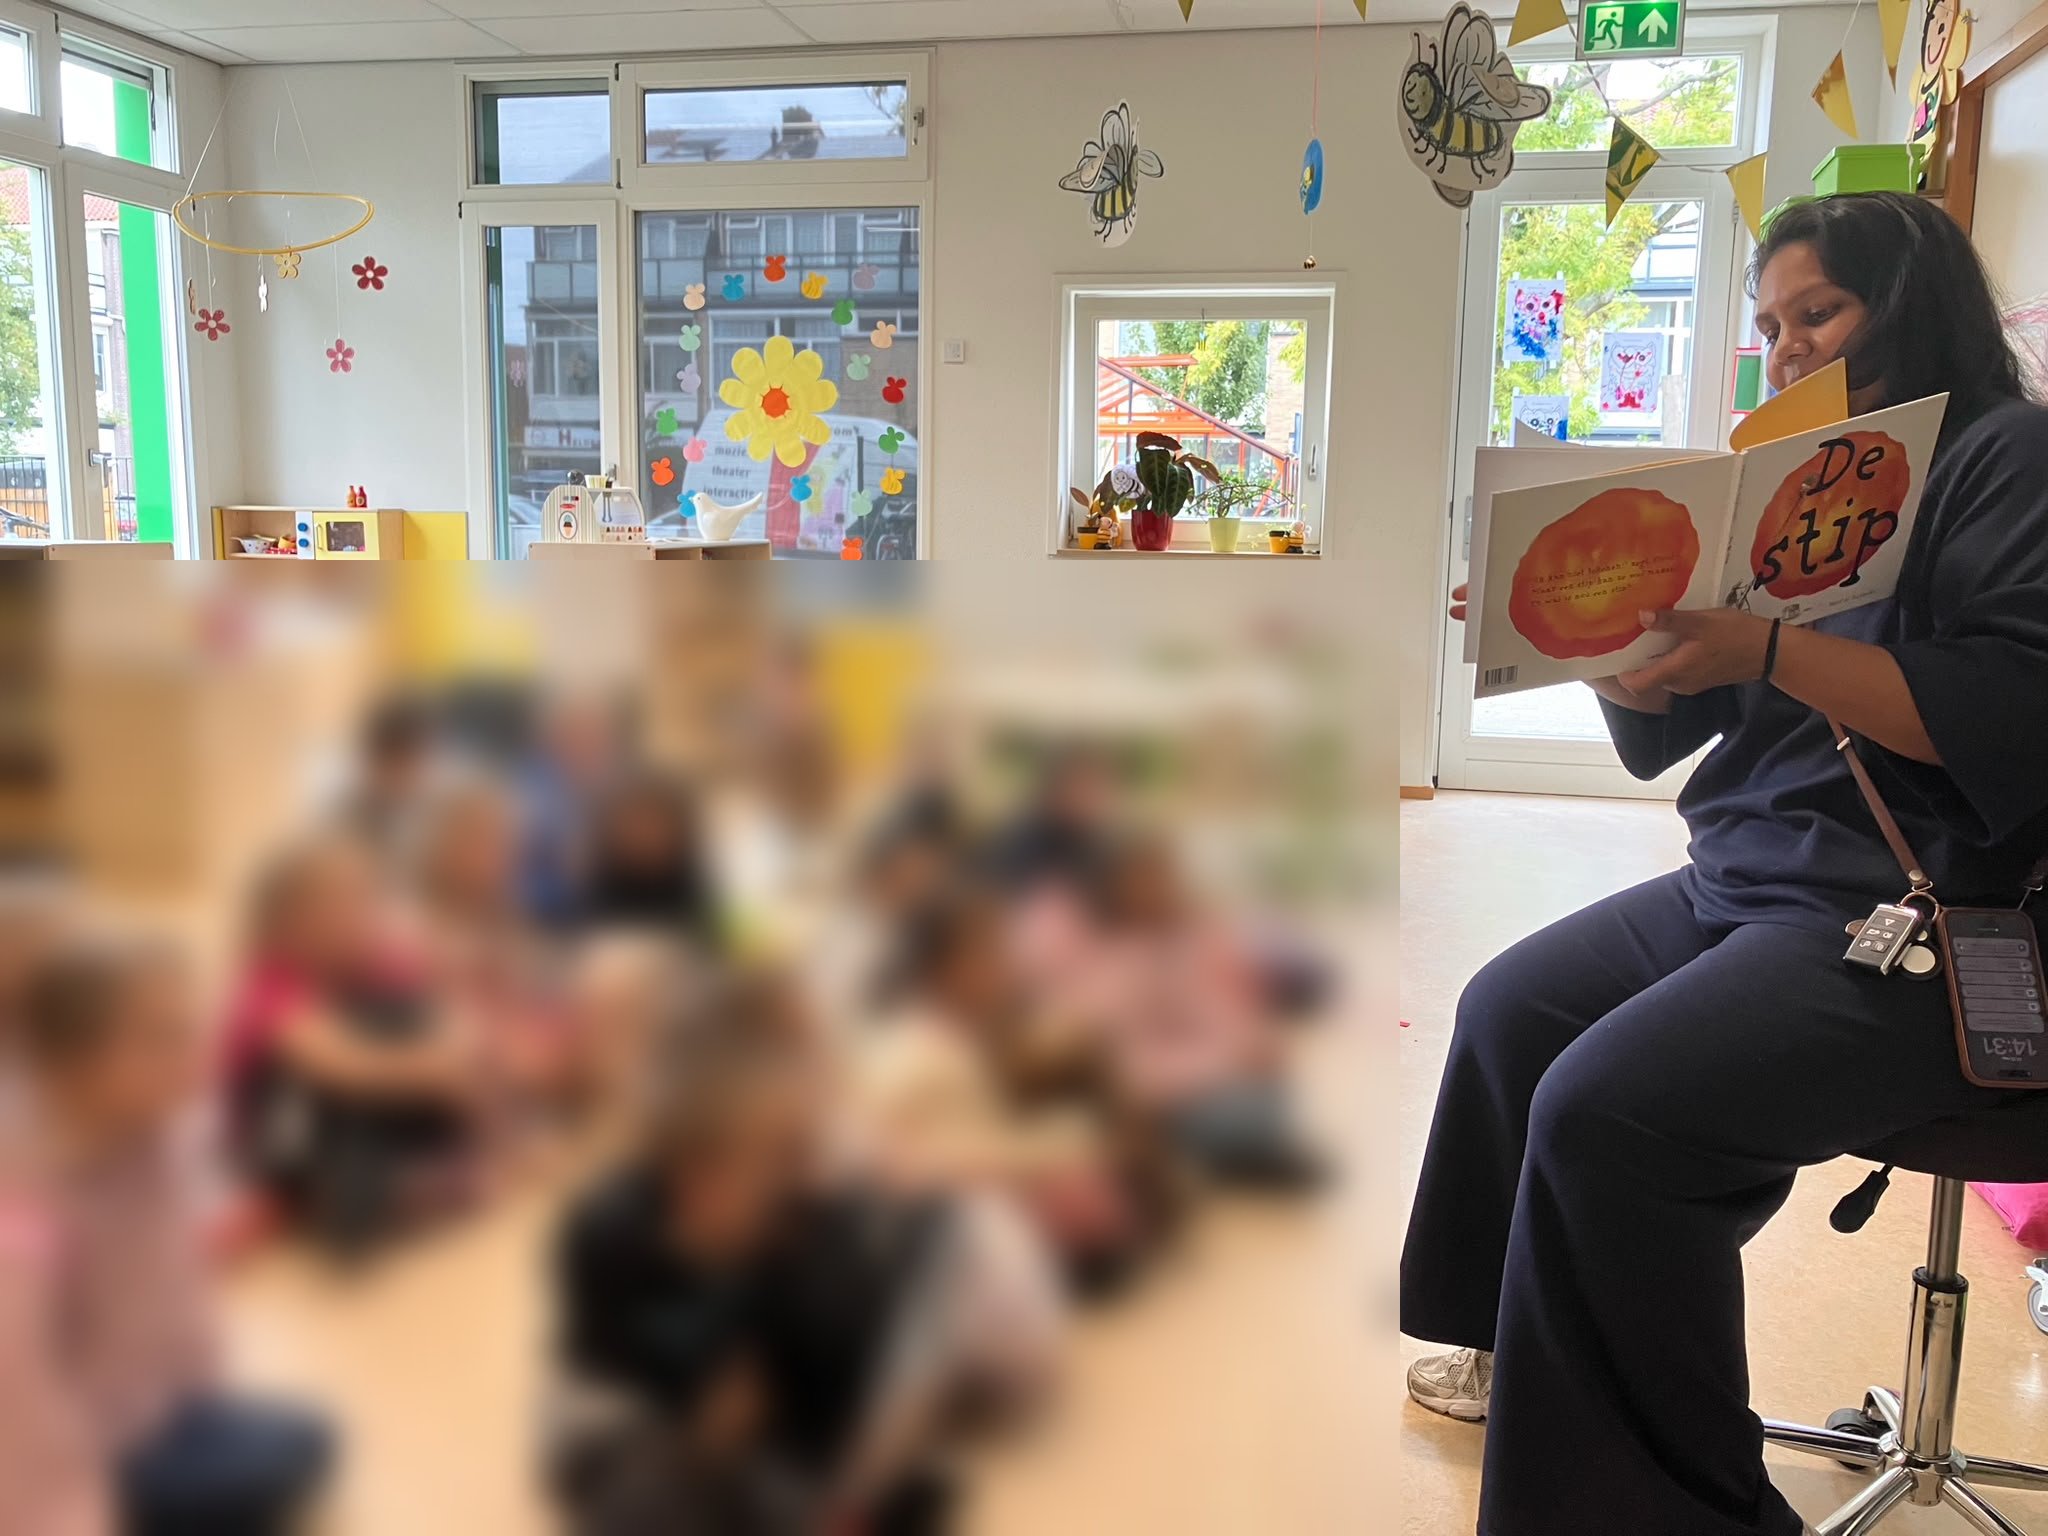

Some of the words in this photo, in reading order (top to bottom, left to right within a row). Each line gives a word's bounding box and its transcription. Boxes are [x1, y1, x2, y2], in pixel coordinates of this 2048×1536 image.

[712, 465, 751, 479] theater
[1806, 437, 1885, 496] De
[1753, 497, 1899, 591] stip
[1983, 1037, 2038, 1056] 14:31
